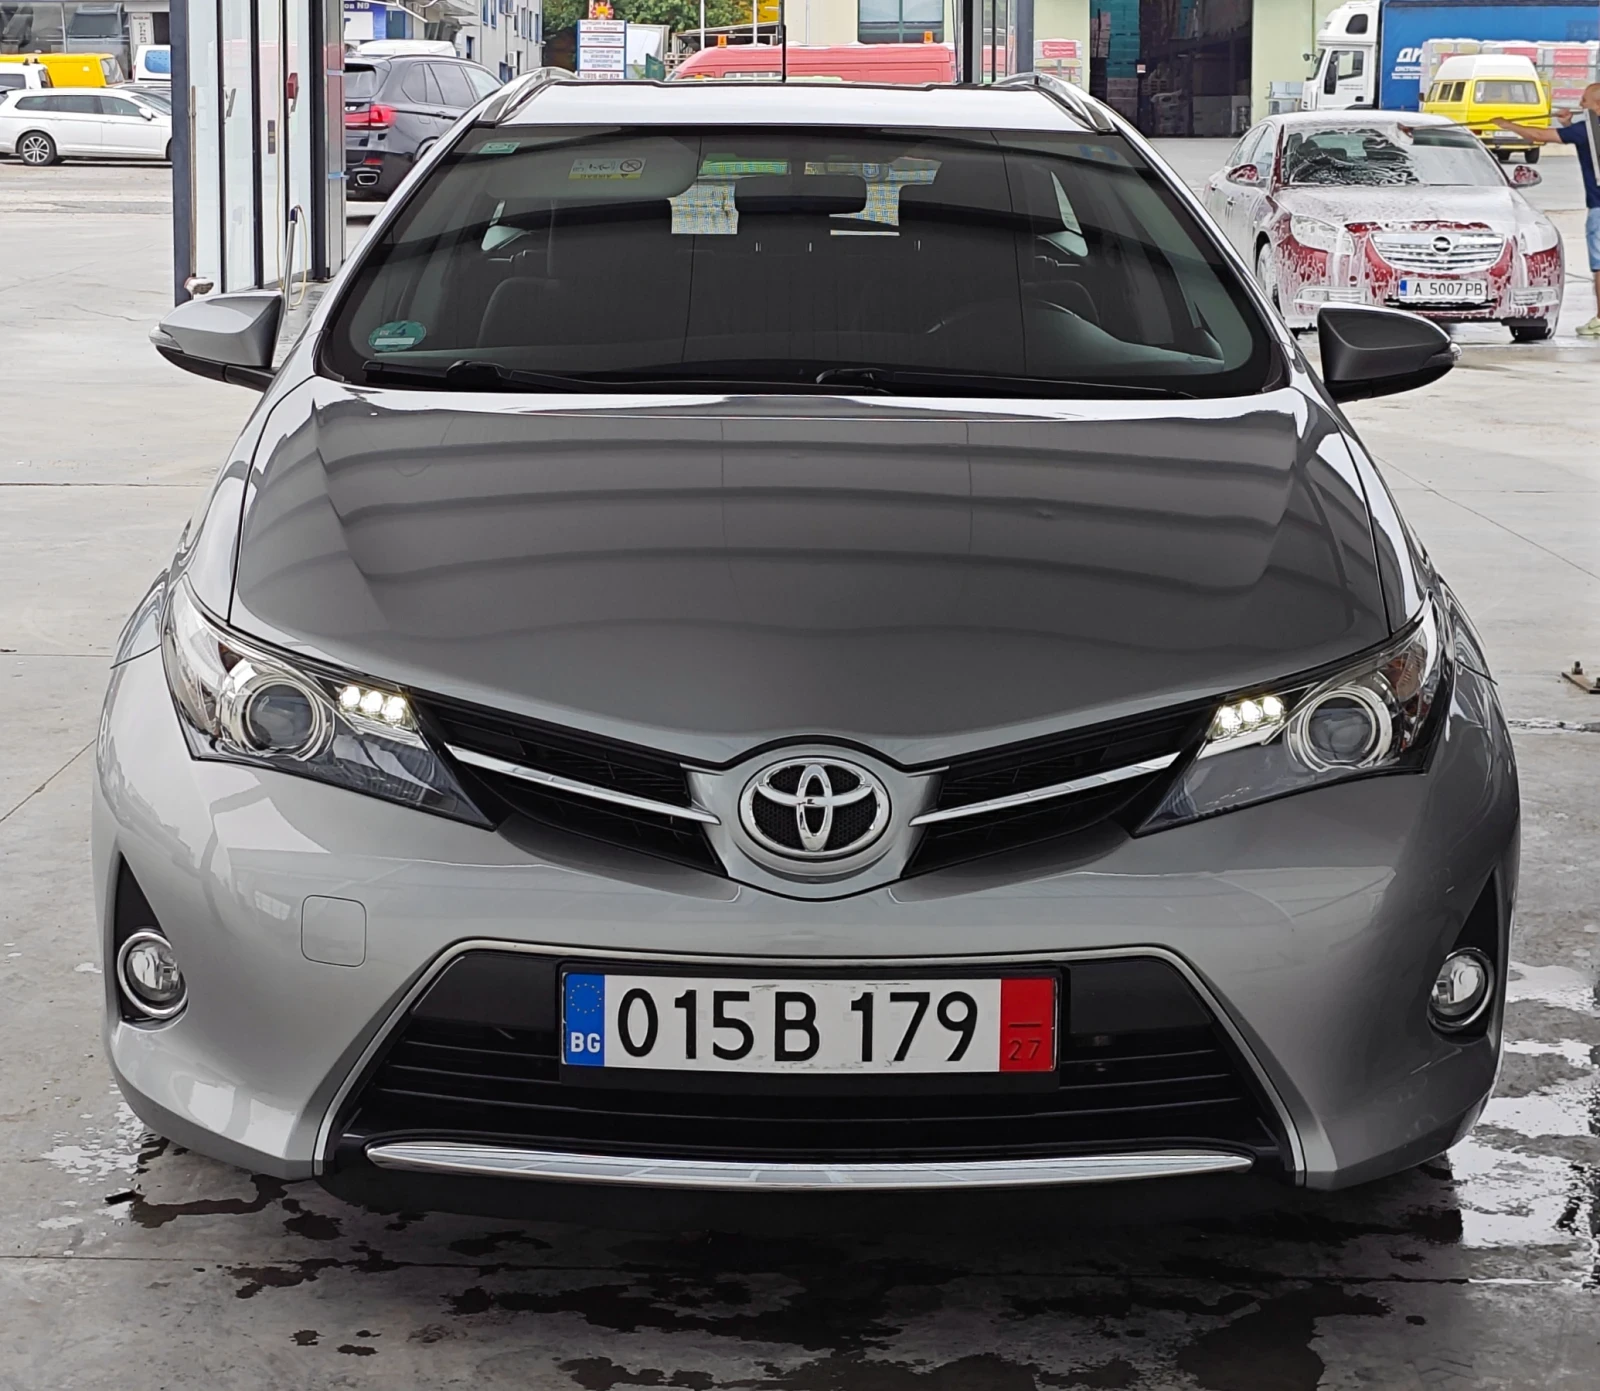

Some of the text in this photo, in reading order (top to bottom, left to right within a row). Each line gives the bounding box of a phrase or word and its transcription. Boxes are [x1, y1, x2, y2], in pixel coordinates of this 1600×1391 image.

[1414, 282, 1422, 295] A
[570, 1031, 601, 1053] BG
[1007, 1037, 1042, 1062] 27
